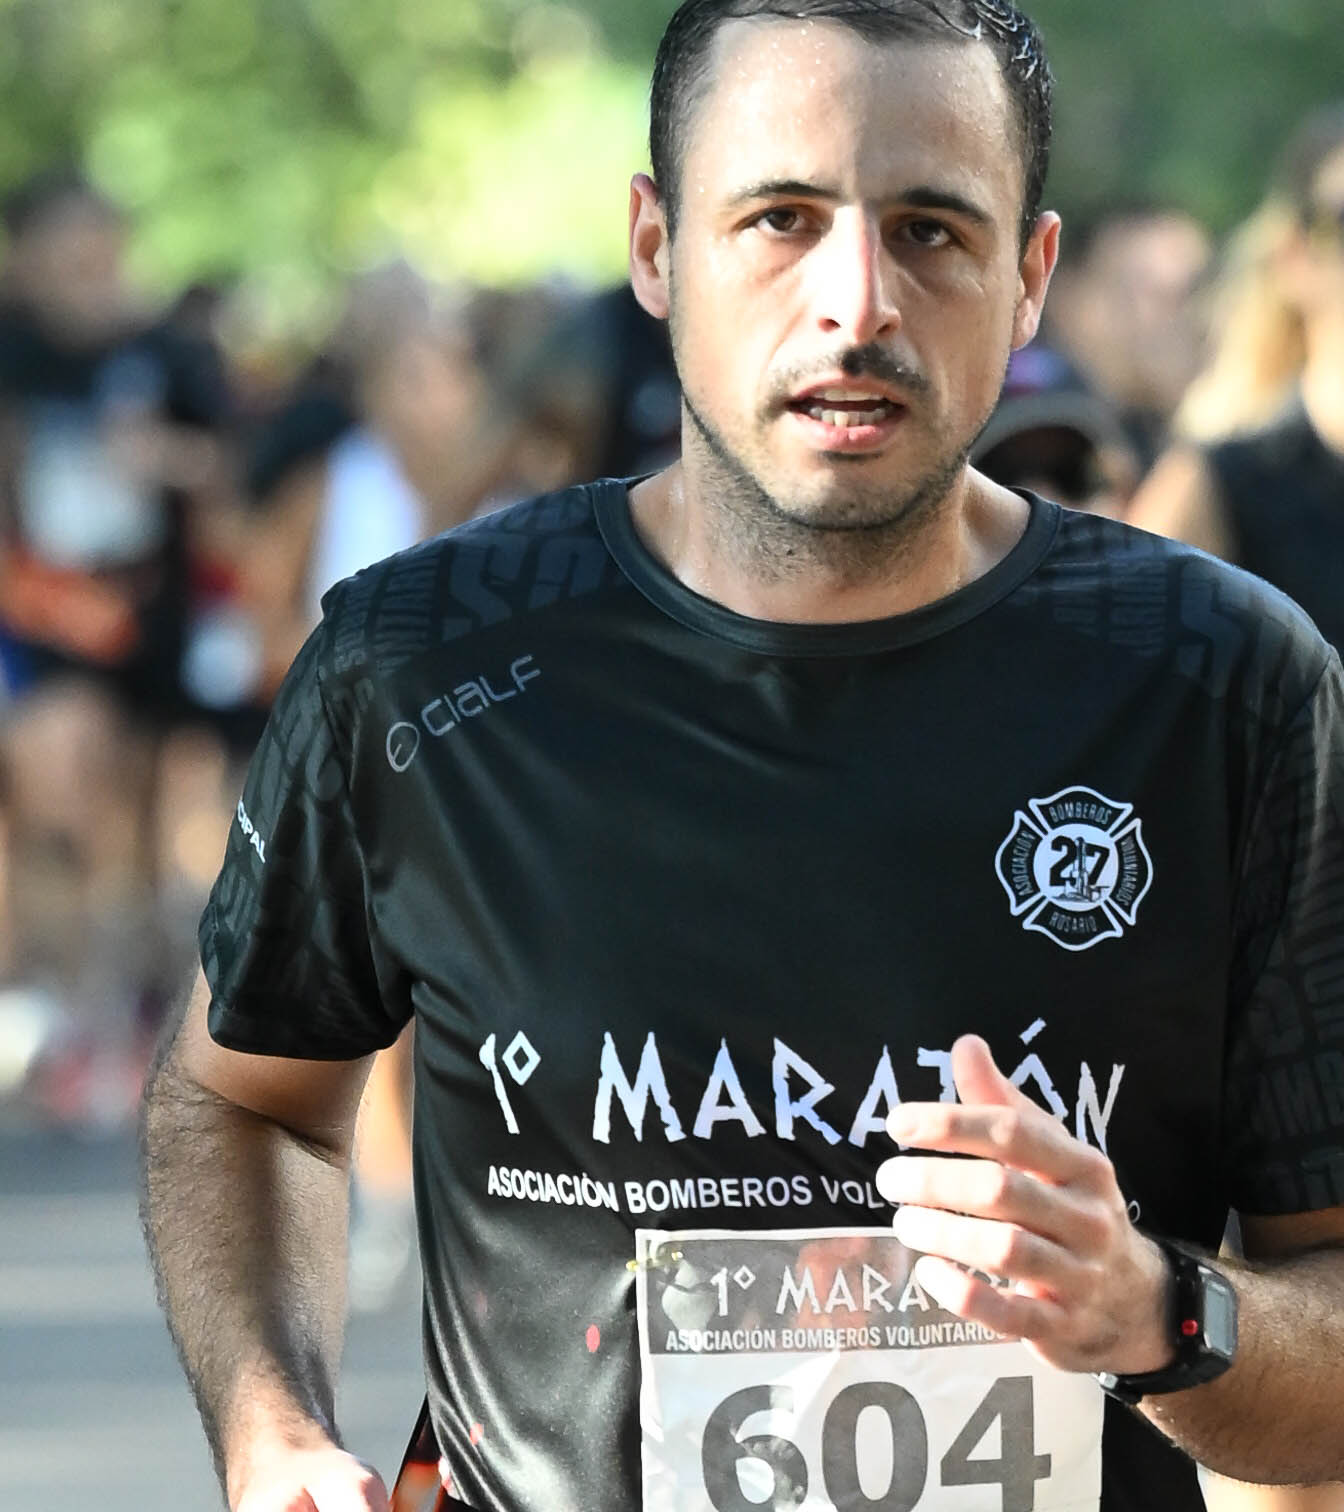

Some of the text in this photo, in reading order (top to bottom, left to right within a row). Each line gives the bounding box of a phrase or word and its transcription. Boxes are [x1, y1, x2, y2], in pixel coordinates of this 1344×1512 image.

[1049, 802, 1112, 825] BOMBEROS
[1049, 835, 1111, 887] 27
[487, 1165, 620, 1212] ASOCIACIÓN
[624, 1175, 813, 1214] BOMBEROS
[666, 1325, 776, 1352] ASOCIACIÓN
[782, 1326, 881, 1351] BOMBEROS
